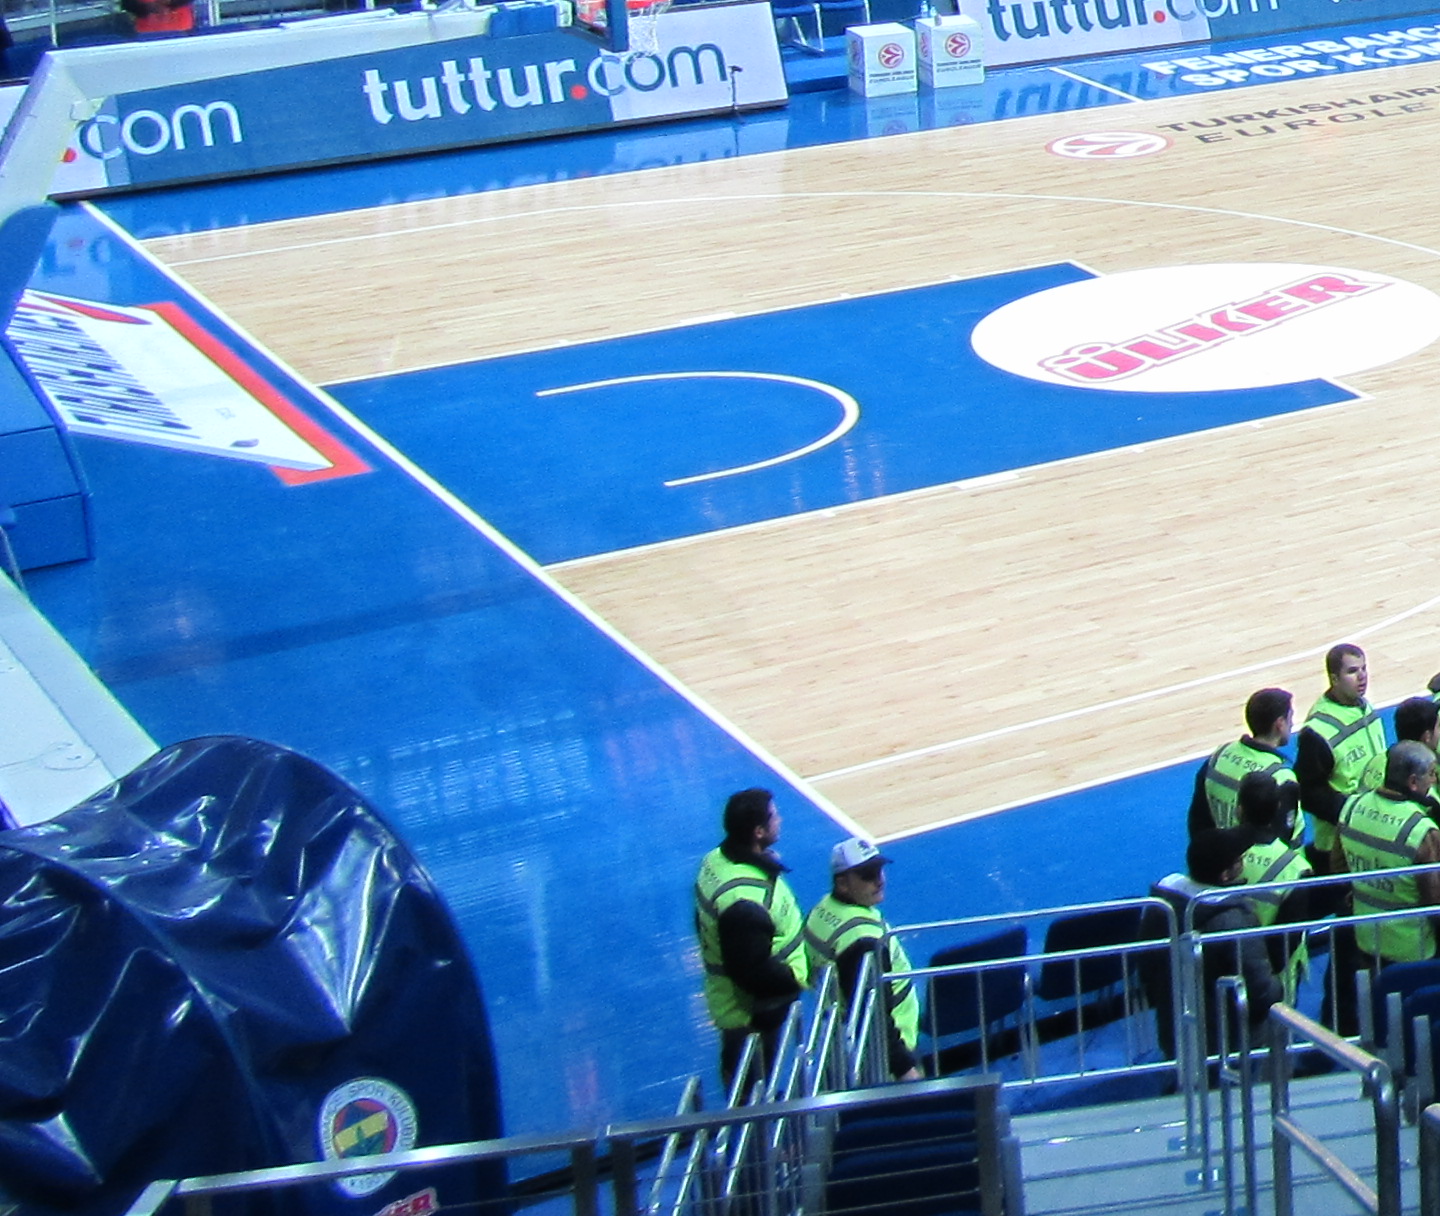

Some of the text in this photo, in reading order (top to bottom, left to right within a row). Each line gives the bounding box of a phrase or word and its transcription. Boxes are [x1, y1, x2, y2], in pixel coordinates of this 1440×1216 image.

[363, 43, 728, 125] tuttur.com
[1180, 58, 1338, 88] SPOR
[1036, 272, 1393, 384] ÜLKER
